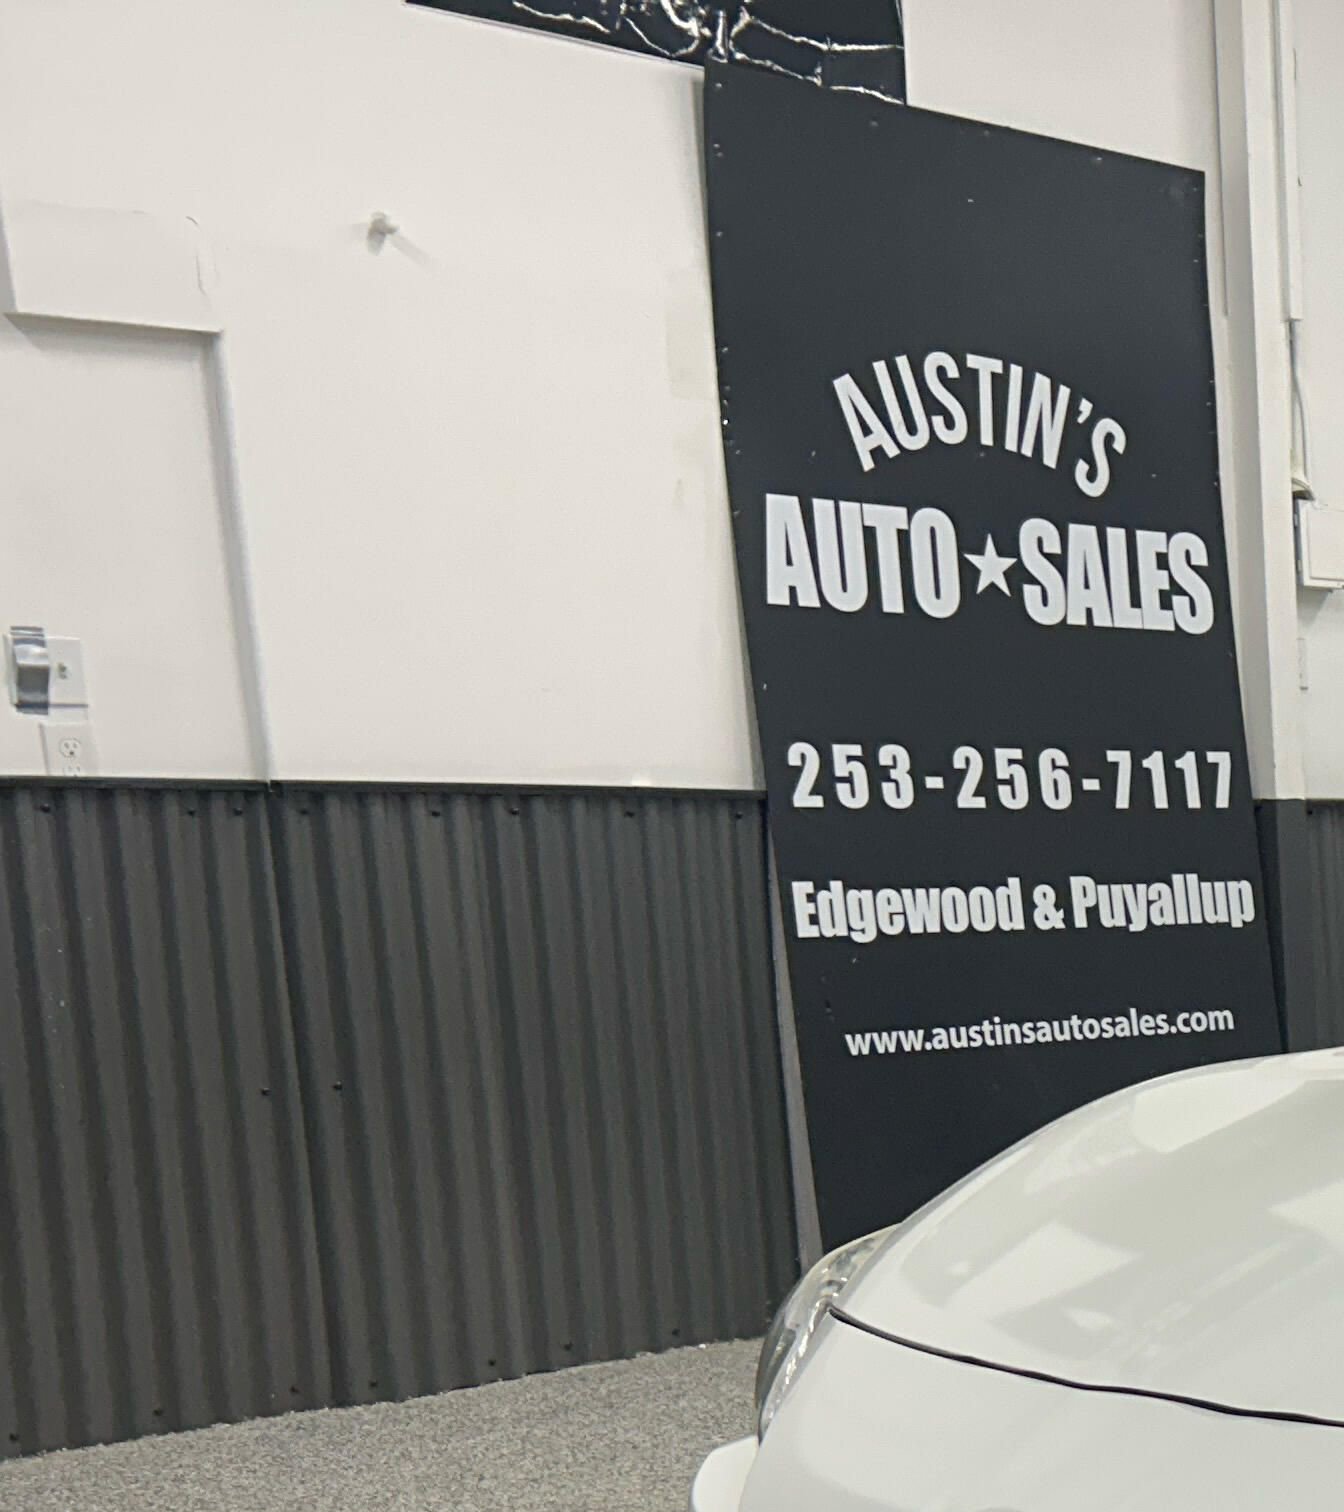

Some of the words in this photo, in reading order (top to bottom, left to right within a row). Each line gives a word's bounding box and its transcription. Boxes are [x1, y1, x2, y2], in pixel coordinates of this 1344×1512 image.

[832, 351, 1126, 498] AUSTIN'S
[765, 493, 961, 619] AUTO
[1018, 517, 1214, 635] SALES
[787, 741, 1232, 810] 253-256-7117
[791, 876, 1025, 944] Edgewood
[1032, 884, 1066, 931] &
[1069, 872, 1255, 932] Puyallup
[844, 1007, 1235, 1057] www.austinsautosales.com
